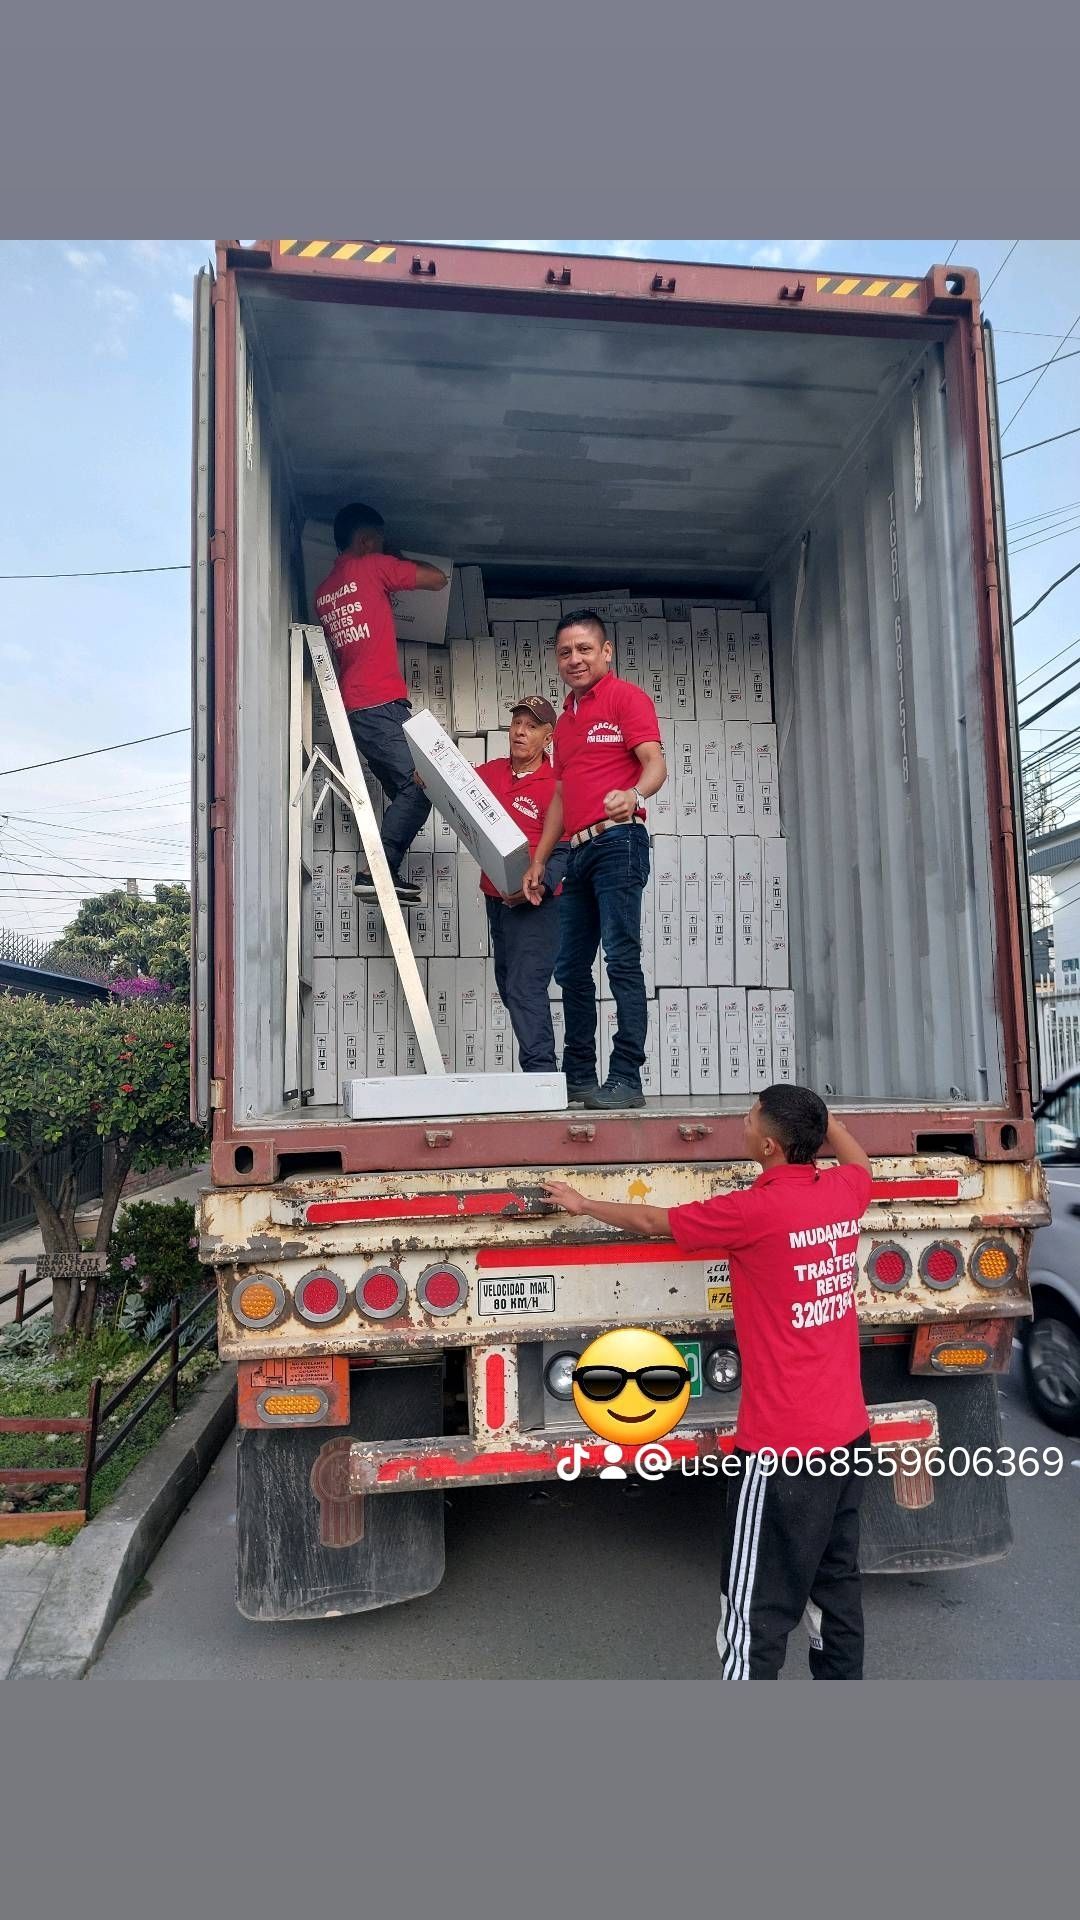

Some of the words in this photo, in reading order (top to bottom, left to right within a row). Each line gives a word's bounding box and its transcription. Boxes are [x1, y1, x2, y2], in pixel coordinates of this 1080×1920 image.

[331, 600, 337, 610] Y
[330, 615, 353, 633] REYES
[828, 1240, 837, 1257] Y
[794, 1251, 857, 1281] TRASTEO
[483, 1282, 525, 1297] VELOCIDAD
[816, 1271, 852, 1297] REYES
[494, 1298, 507, 1309] 80
[510, 1297, 539, 1309] KM/H
